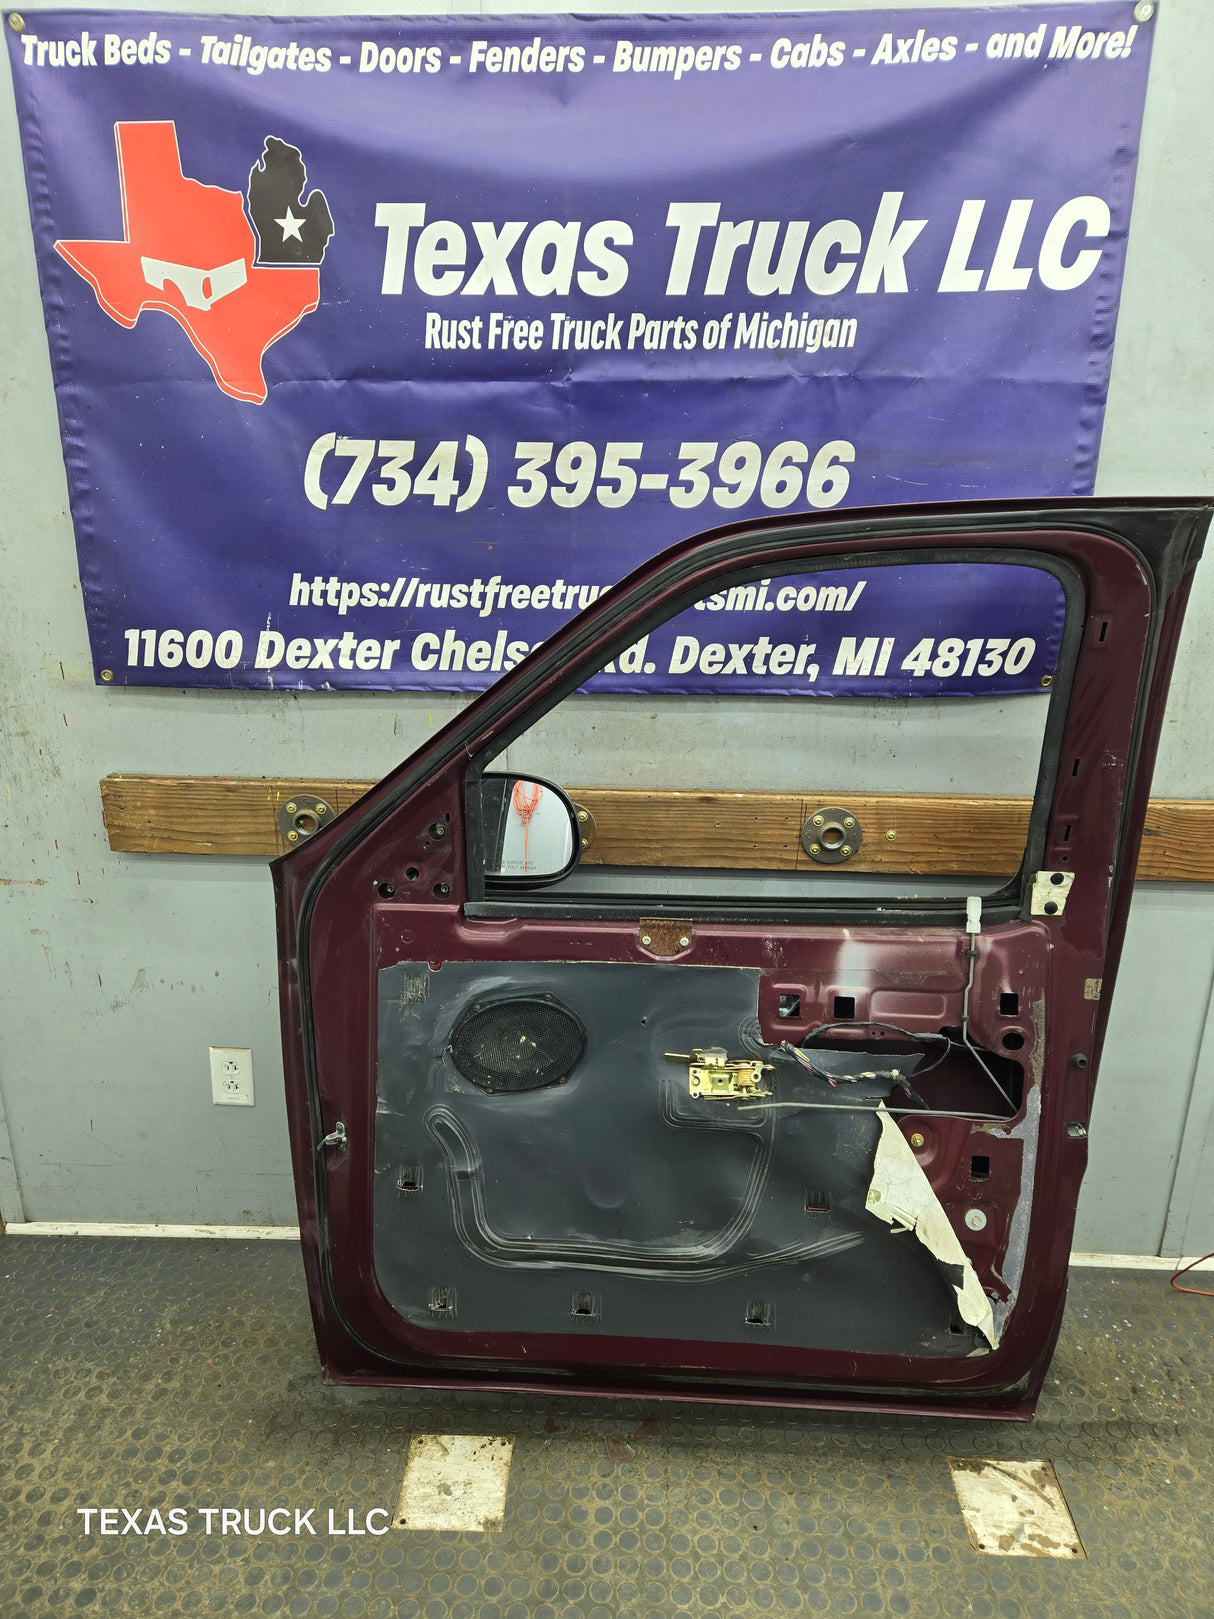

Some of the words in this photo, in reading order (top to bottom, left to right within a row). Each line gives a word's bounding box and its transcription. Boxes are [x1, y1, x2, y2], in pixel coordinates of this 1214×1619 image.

[21, 32, 97, 66] Truck
[105, 32, 171, 65] Beds
[179, 48, 191, 56] -
[201, 34, 332, 75] Tailgates
[340, 56, 351, 64] -
[359, 42, 441, 73] Doors
[450, 56, 461, 64] -
[469, 39, 585, 72] Fenders
[613, 41, 742, 80] Bumpers
[749, 53, 762, 61] -
[770, 34, 845, 69] Cabs
[853, 49, 866, 57] -
[871, 29, 958, 65] Axles
[965, 43, 979, 52] -
[986, 24, 1047, 58] and
[1048, 25, 1138, 59] More!
[375, 203, 633, 296] Texas
[666, 192, 928, 296] Truck
[938, 196, 1110, 292] LLC
[425, 313, 482, 350] Rust
[488, 313, 543, 350] Free
[551, 313, 622, 350] Truck
[628, 313, 699, 350] Parts
[703, 313, 732, 350] of
[735, 311, 857, 353] Michigan
[304, 432, 488, 512] (734)
[508, 441, 855, 508] 395-3966
[125, 629, 242, 668] 11600
[255, 629, 400, 670] Dexter
[412, 630, 545, 671] Chels
[599, 634, 656, 674] d.
[669, 636, 819, 681] Dexter,
[832, 638, 895, 676] MI
[901, 638, 1036, 677] 48130
